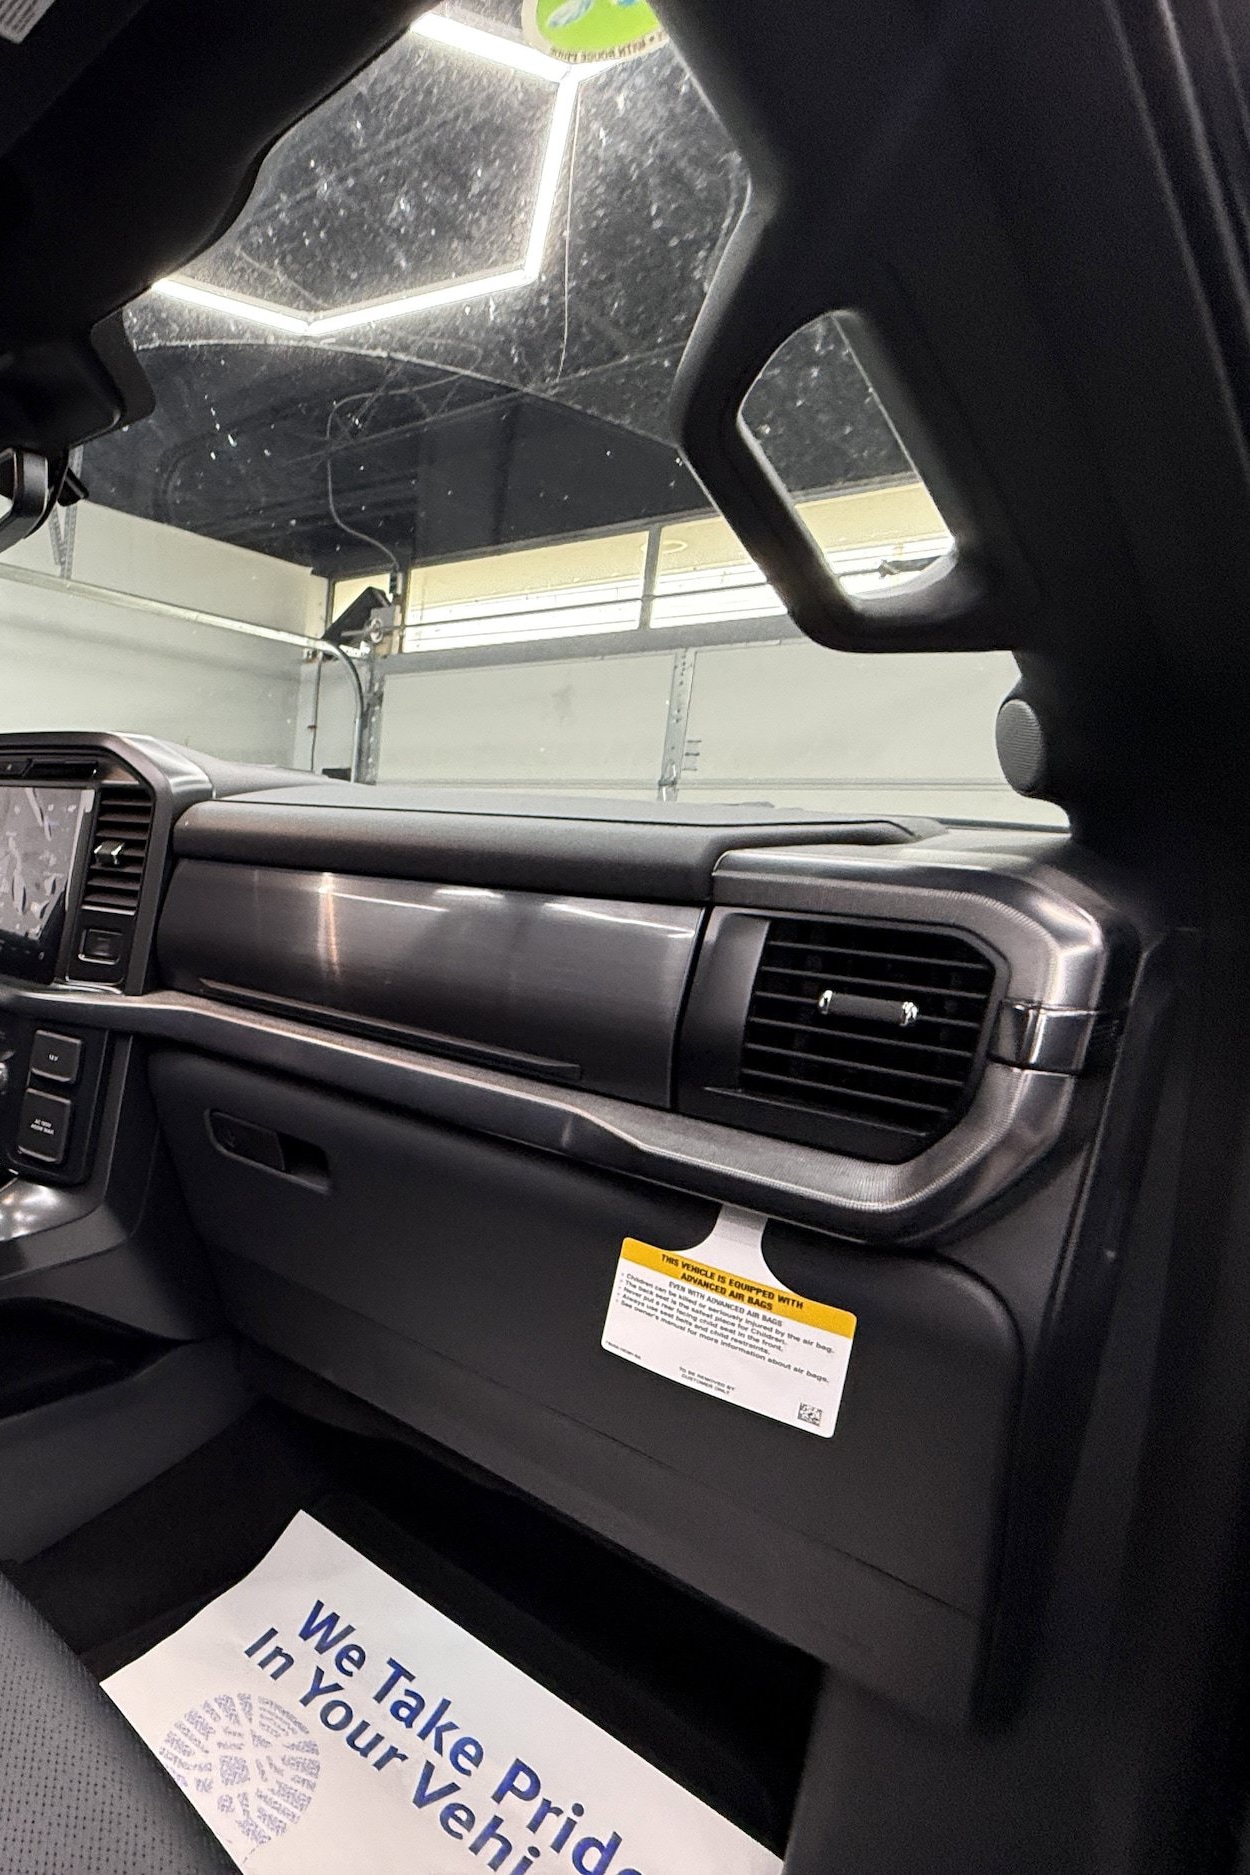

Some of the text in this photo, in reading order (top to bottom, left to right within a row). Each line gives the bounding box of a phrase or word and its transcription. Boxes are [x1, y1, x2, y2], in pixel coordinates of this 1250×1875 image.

[625, 1280, 637, 1289] The
[638, 1285, 654, 1296] back
[655, 1293, 669, 1302] seat
[678, 1300, 690, 1310] the
[691, 1307, 713, 1319] safest
[715, 1316, 736, 1327] place
[737, 1323, 749, 1331] for
[662, 1254, 803, 1309] THIS VEHICLE IS EQUIPPED WITH
[669, 1281, 783, 1327] EVEN WITH ADVANCED AIR BAGS
[680, 1272, 773, 1311] ADVANCED AIR BAGS
[622, 1293, 645, 1308] Always
[660, 1310, 674, 1319] seat
[675, 1316, 692, 1327] belts
[694, 1324, 708, 1332] and
[710, 1329, 729, 1340] child
[624, 1287, 642, 1298] Never
[643, 1295, 655, 1304] put
[661, 1303, 675, 1311] rear
[676, 1308, 698, 1322] facing
[699, 1318, 718, 1329] child
[720, 1326, 736, 1335] seat
[747, 1334, 760, 1343] the
[626, 1273, 654, 1288] Children
[655, 1285, 667, 1293] can
[669, 1290, 677, 1298] be
[678, 1294, 697, 1306] killed
[708, 1306, 744, 1322] seriously
[745, 1318, 773, 1333] injured
[775, 1328, 785, 1338] by
[787, 1333, 801, 1342] the
[803, 1338, 815, 1346] air
[816, 1341, 835, 1354] bag.
[621, 1300, 830, 1383] See owner's manual for more information about air bags.
[244, 1627, 295, 1680] In
[298, 1665, 409, 1771] Your
[298, 1600, 644, 1875] We Take Prid
